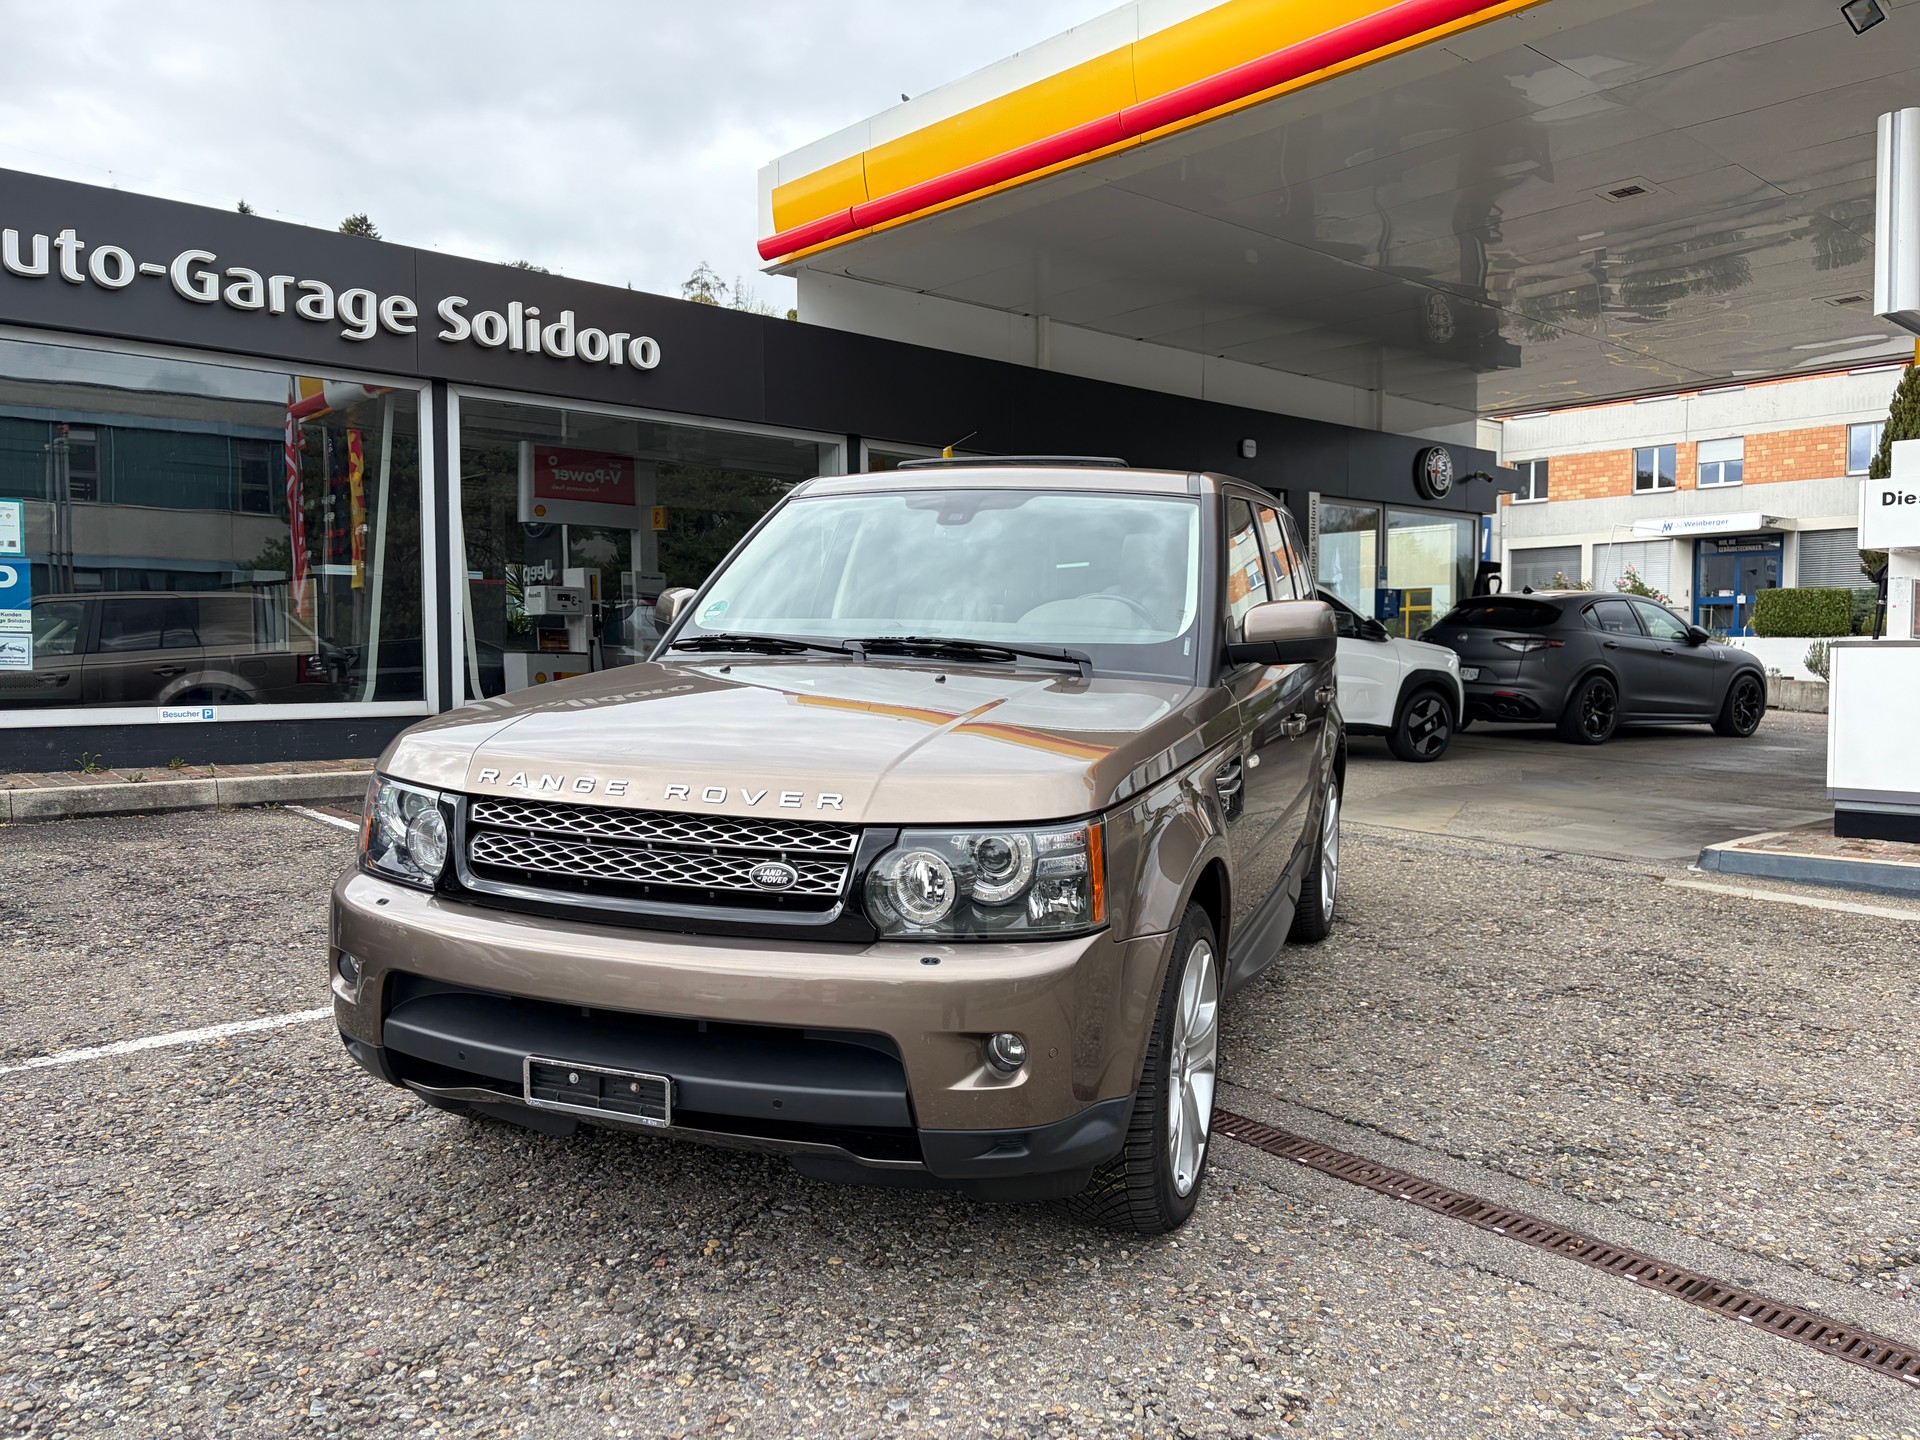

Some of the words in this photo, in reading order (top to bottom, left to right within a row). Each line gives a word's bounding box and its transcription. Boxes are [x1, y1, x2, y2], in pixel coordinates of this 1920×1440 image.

[437, 295, 661, 371] Solidoro
[1882, 490, 1920, 506] Die
[1684, 519, 1729, 528] Weinberger
[162, 710, 200, 718] Besucher
[477, 767, 629, 797] RANGE
[663, 783, 844, 811] ROVER
[760, 868, 782, 876] LAND
[761, 875, 789, 884] ROVER
